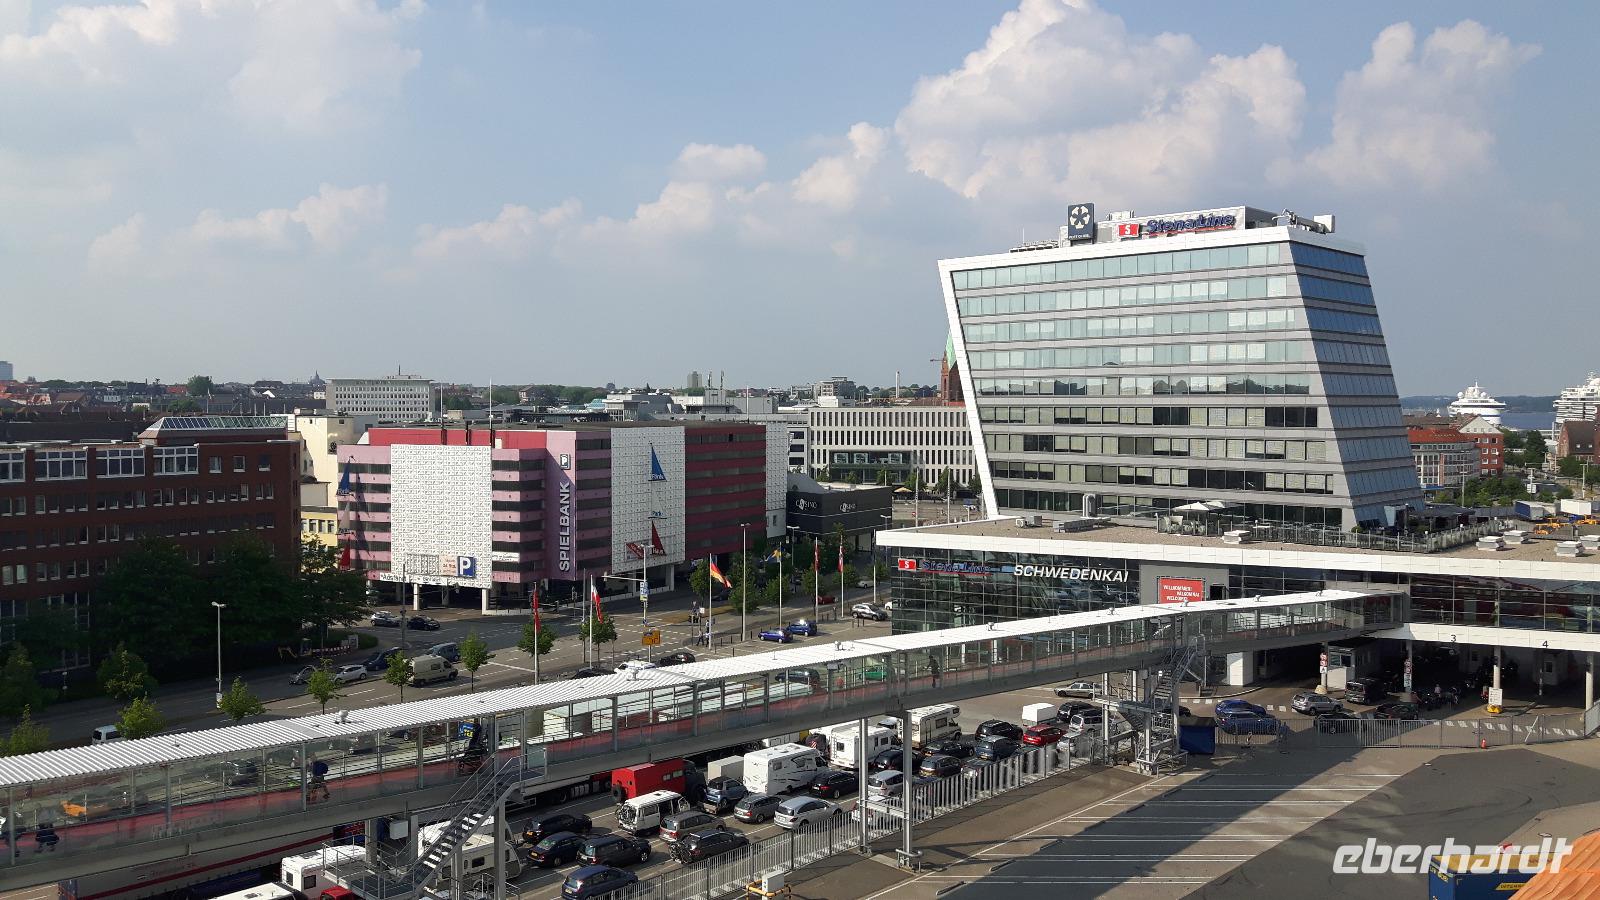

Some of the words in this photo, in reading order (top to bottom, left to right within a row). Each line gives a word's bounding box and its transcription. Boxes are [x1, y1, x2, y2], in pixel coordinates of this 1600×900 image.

[1147, 218, 1200, 233] Stena
[1199, 213, 1236, 228] Line
[559, 482, 570, 572] SPIELBANK
[459, 556, 472, 576] P
[1014, 564, 1129, 583] SCHWEDENKAI
[1450, 634, 1457, 642] 3
[1542, 640, 1549, 648] 4
